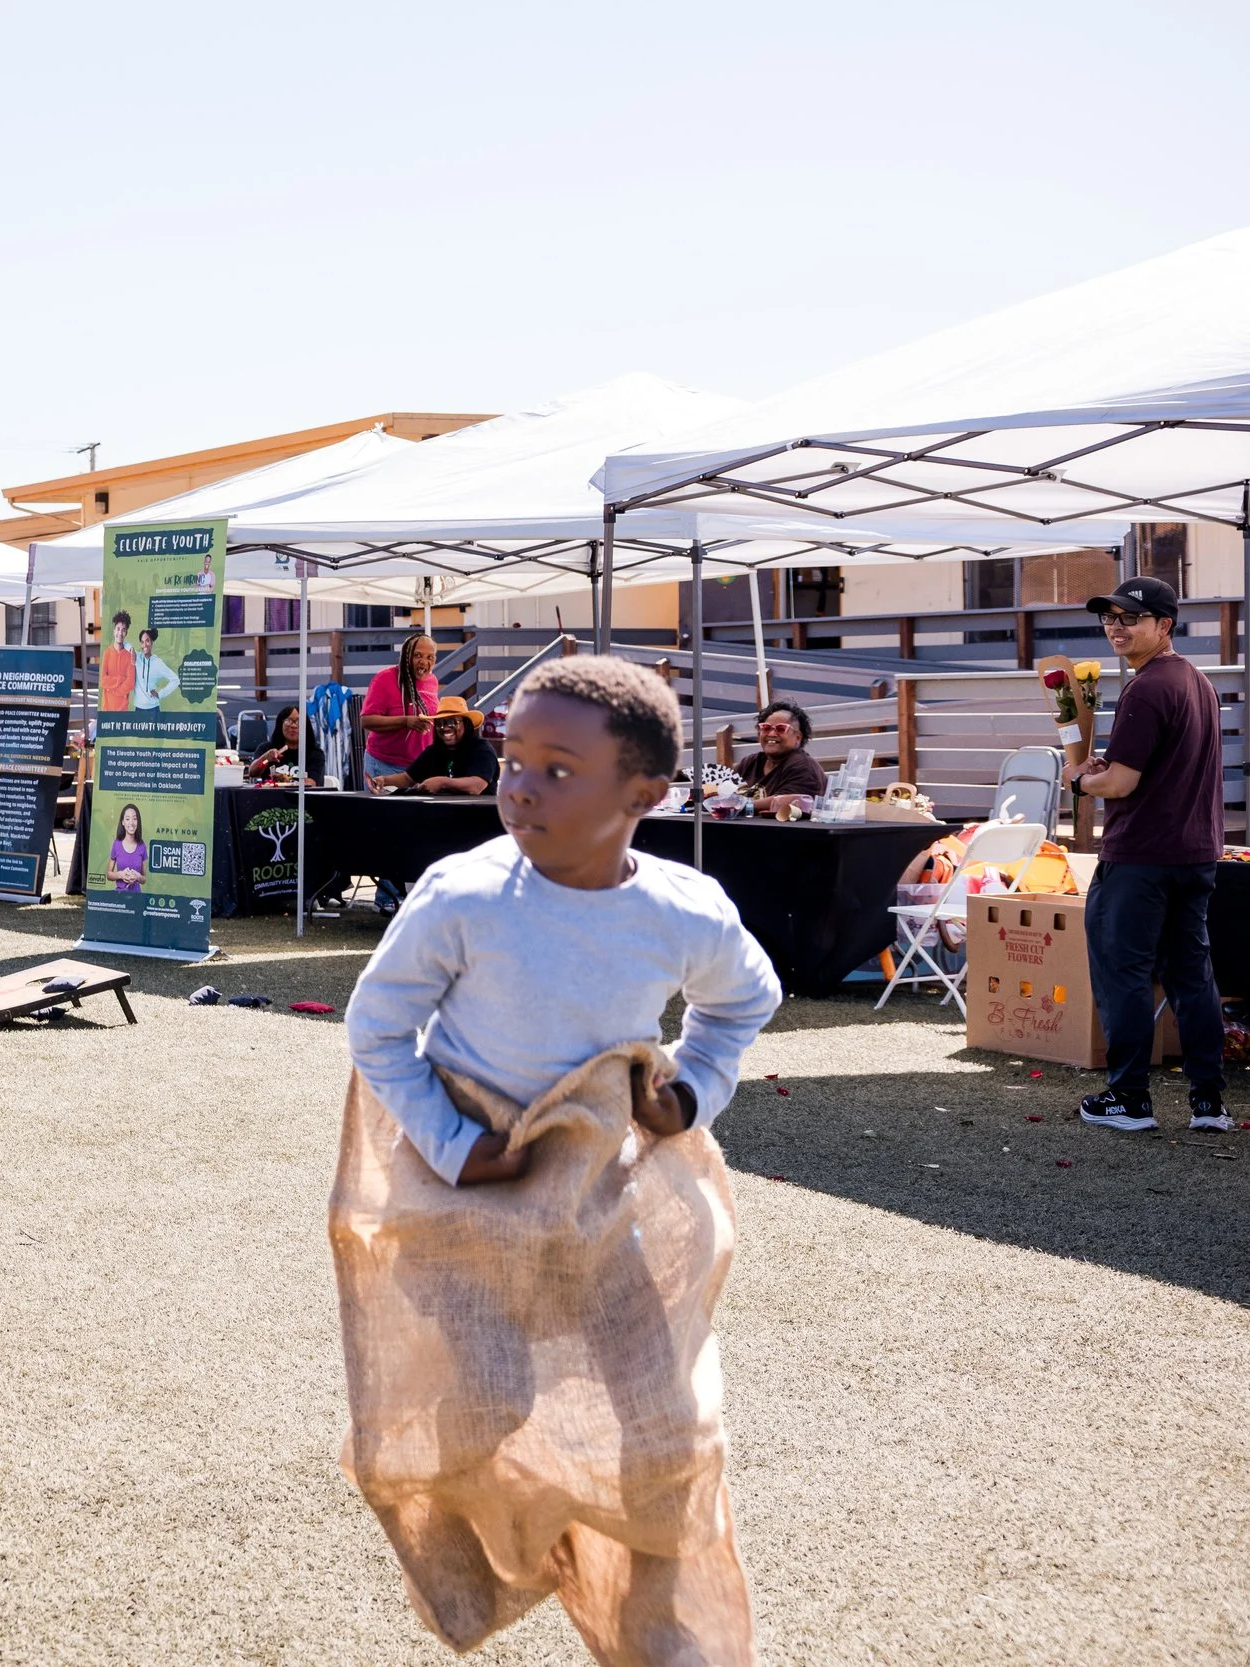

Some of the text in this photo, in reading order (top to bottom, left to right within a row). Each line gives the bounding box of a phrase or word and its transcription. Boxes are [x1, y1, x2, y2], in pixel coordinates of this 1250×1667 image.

[120, 534, 209, 552] ELEVATE YOUTH
[3, 672, 64, 683] NEIGHBORHOOD
[8, 682, 55, 692] COMMITTEES
[163, 847, 181, 855] SCAN
[162, 856, 181, 868] ME!
[1006, 942, 1045, 955] FRESH CUT
[1007, 952, 1043, 965] FLOWERS
[1105, 1105, 1126, 1115] HOKA
